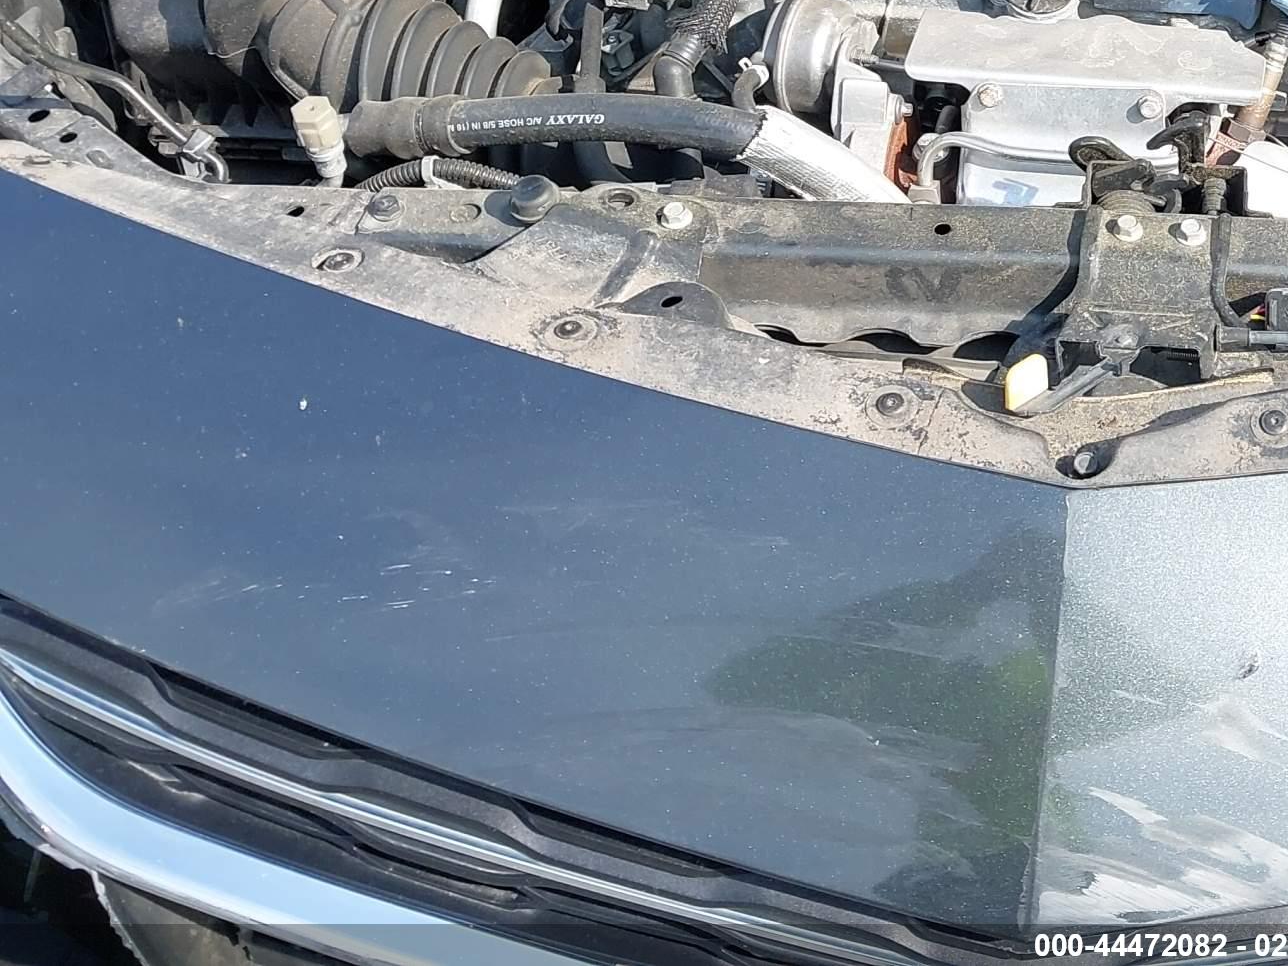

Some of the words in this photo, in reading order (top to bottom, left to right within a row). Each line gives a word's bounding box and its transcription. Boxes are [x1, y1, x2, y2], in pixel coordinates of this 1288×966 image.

[483, 119, 496, 129] 5/8
[498, 117, 524, 128] HOSE
[527, 117, 542, 126] A/C
[546, 113, 605, 125] GALAXY
[471, 122, 480, 130] IN
